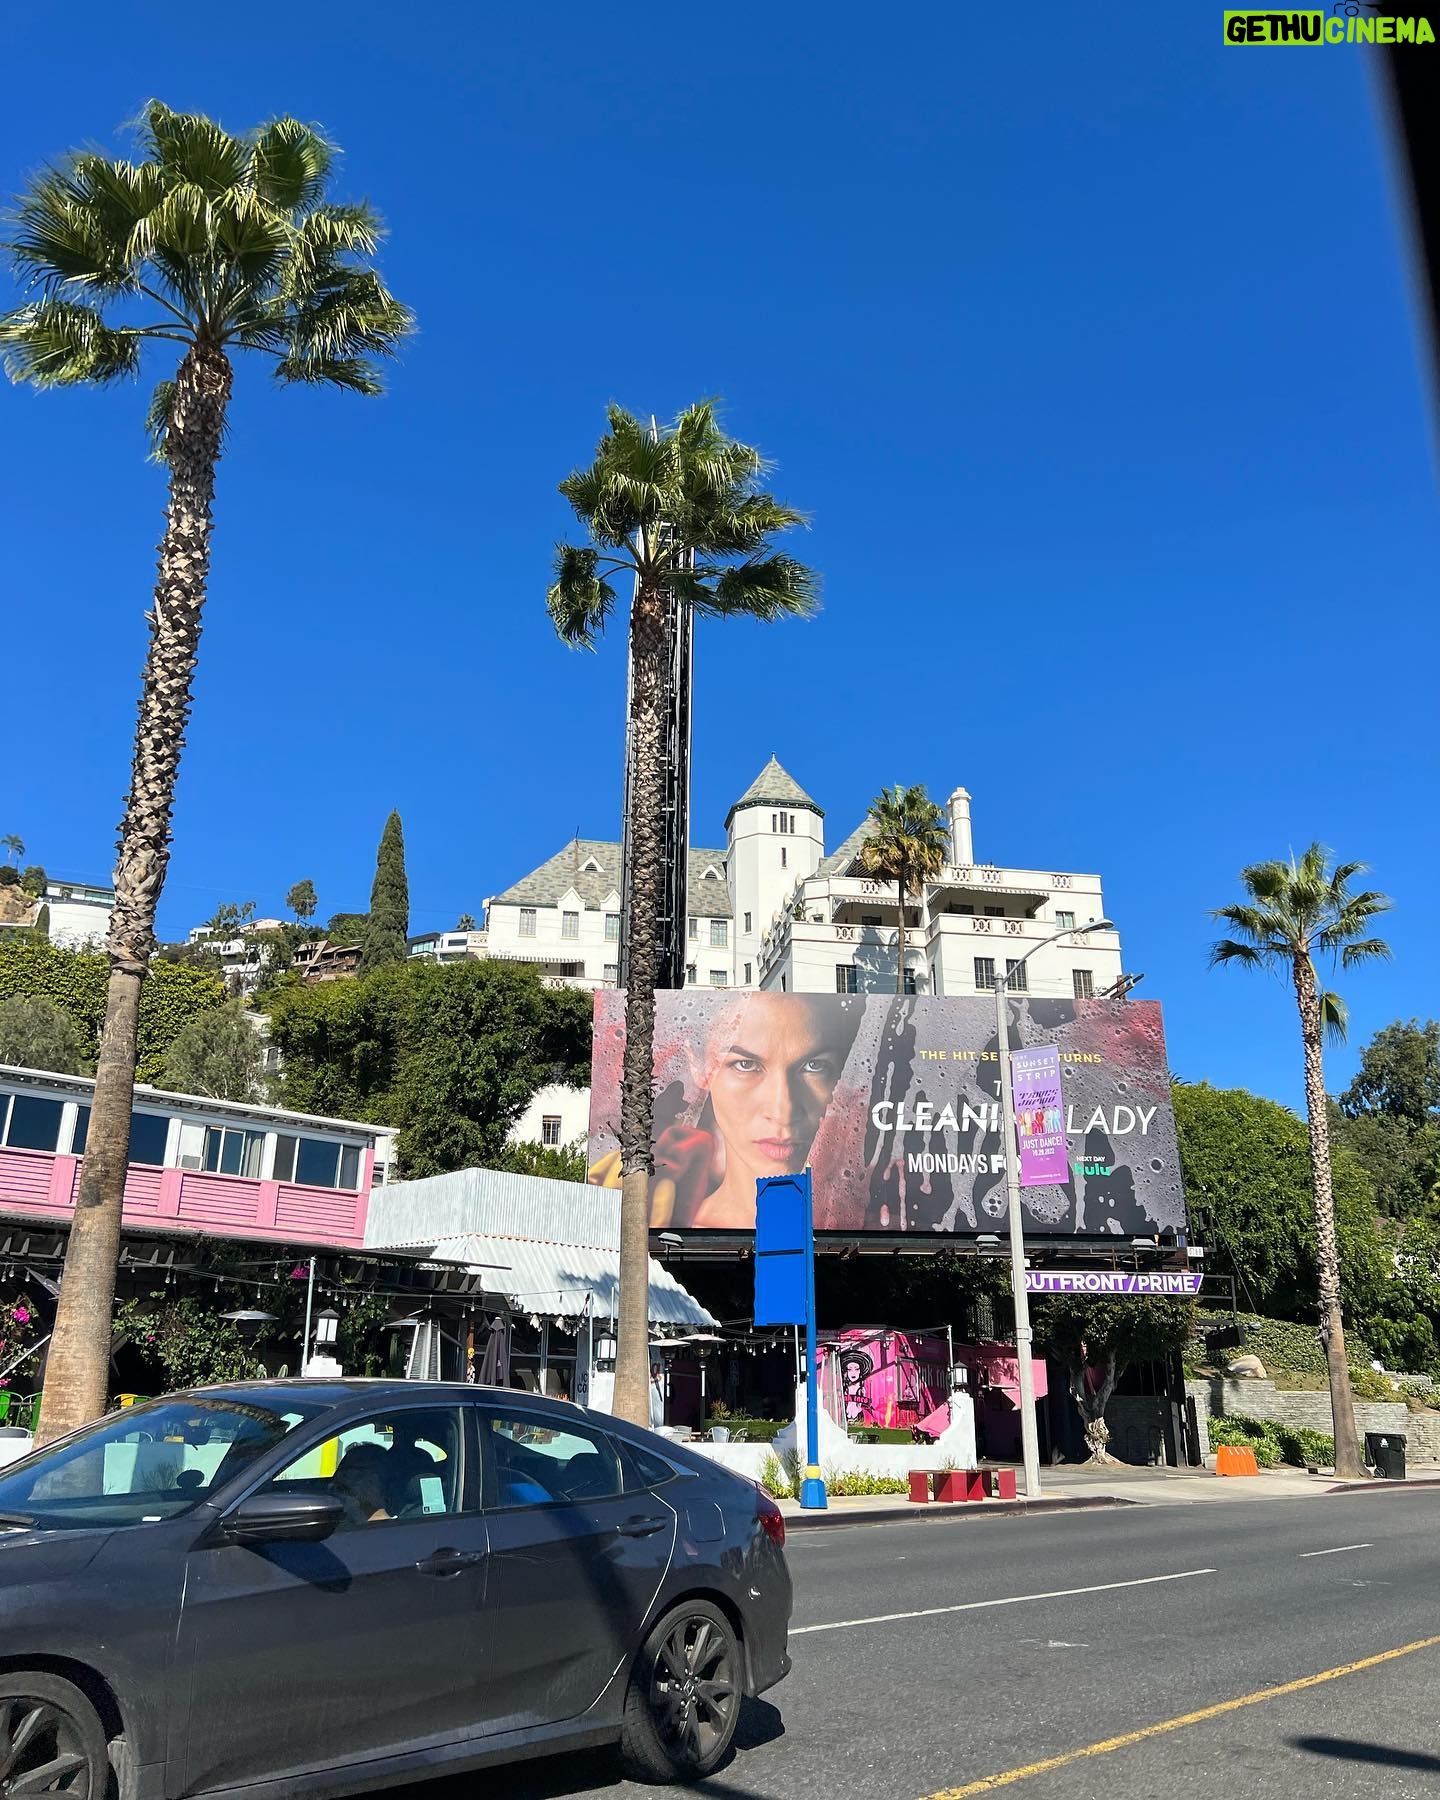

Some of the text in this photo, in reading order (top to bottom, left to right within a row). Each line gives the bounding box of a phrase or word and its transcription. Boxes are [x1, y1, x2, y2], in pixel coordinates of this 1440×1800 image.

[919, 1050, 947, 1060] THE
[953, 1051, 976, 1061] HIT
[1058, 1053, 1102, 1064] TURNS
[1016, 1056, 1055, 1069] SUNSET
[1017, 1069, 1056, 1082] STRIP
[872, 1101, 1157, 1135] CLEANI LADY
[1022, 1136, 1063, 1150] JUST DANCE!
[908, 1153, 988, 1174] MONDAYS
[1074, 1162, 1111, 1176] hulu
